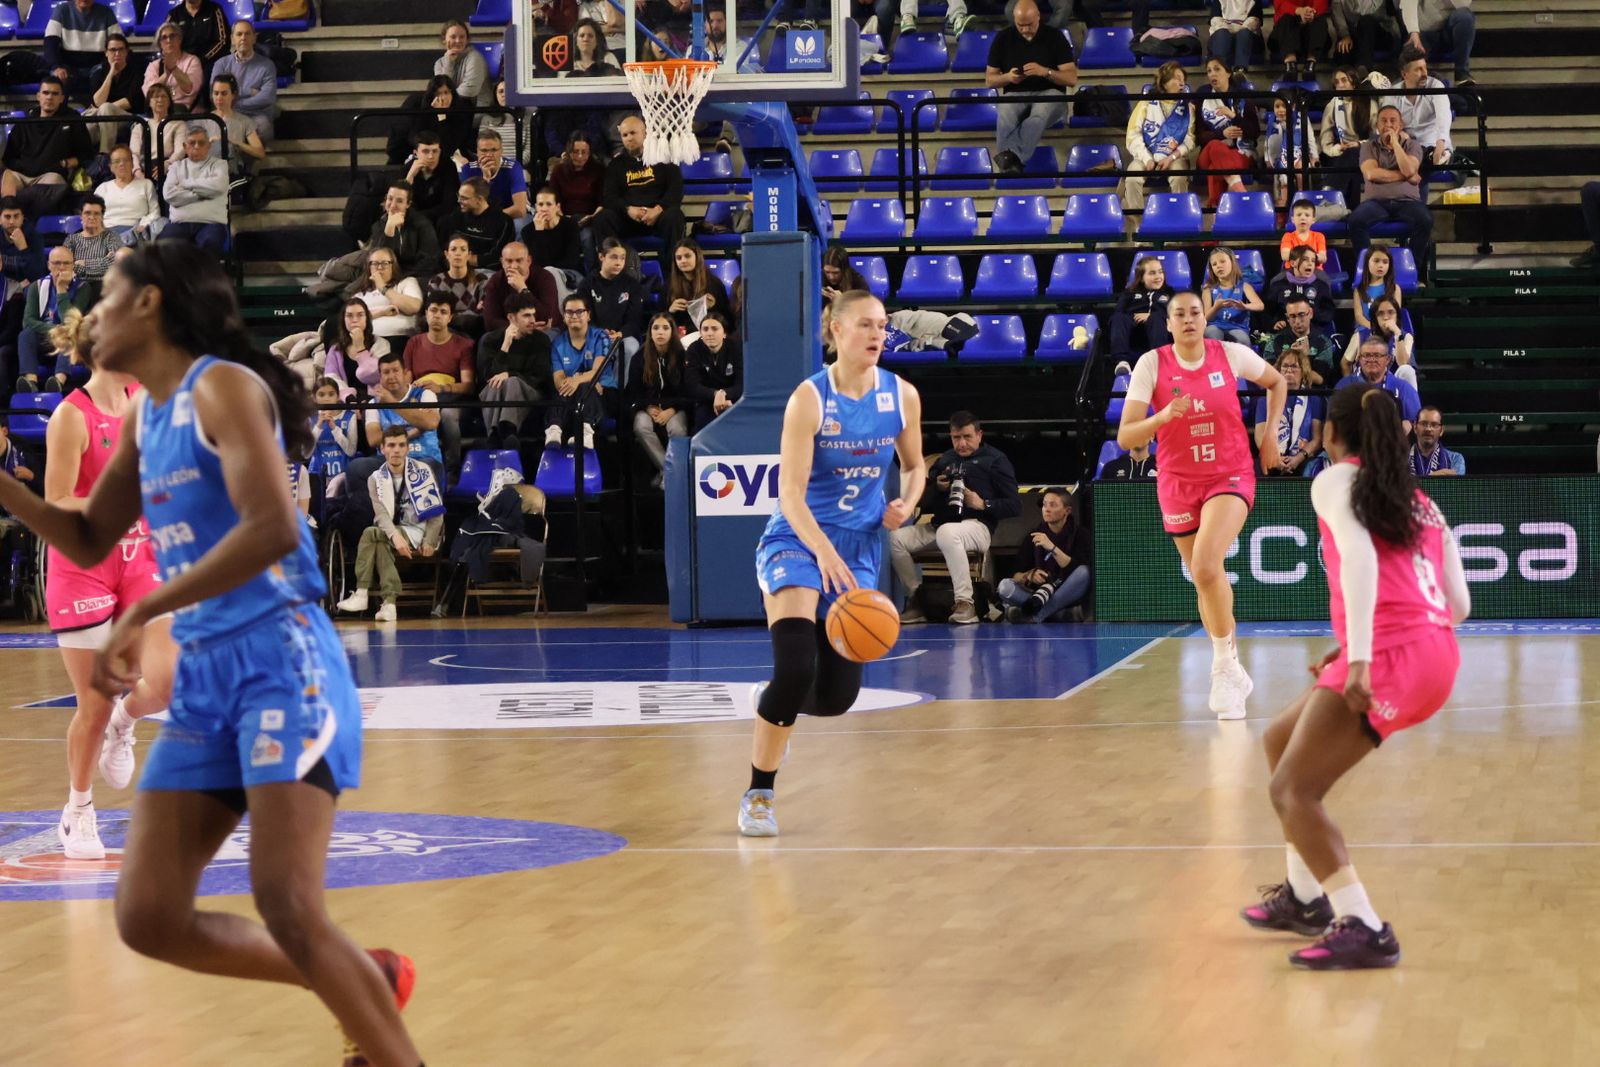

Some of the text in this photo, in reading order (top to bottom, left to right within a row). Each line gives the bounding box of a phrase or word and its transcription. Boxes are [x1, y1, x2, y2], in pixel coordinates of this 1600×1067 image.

[768, 187, 779, 231] MONDO
[819, 441, 863, 450] CASTILLA
[867, 440, 874, 449] Y
[1190, 443, 1216, 463] 15
[327, 461, 341, 476] 10
[838, 484, 860, 512] 2
